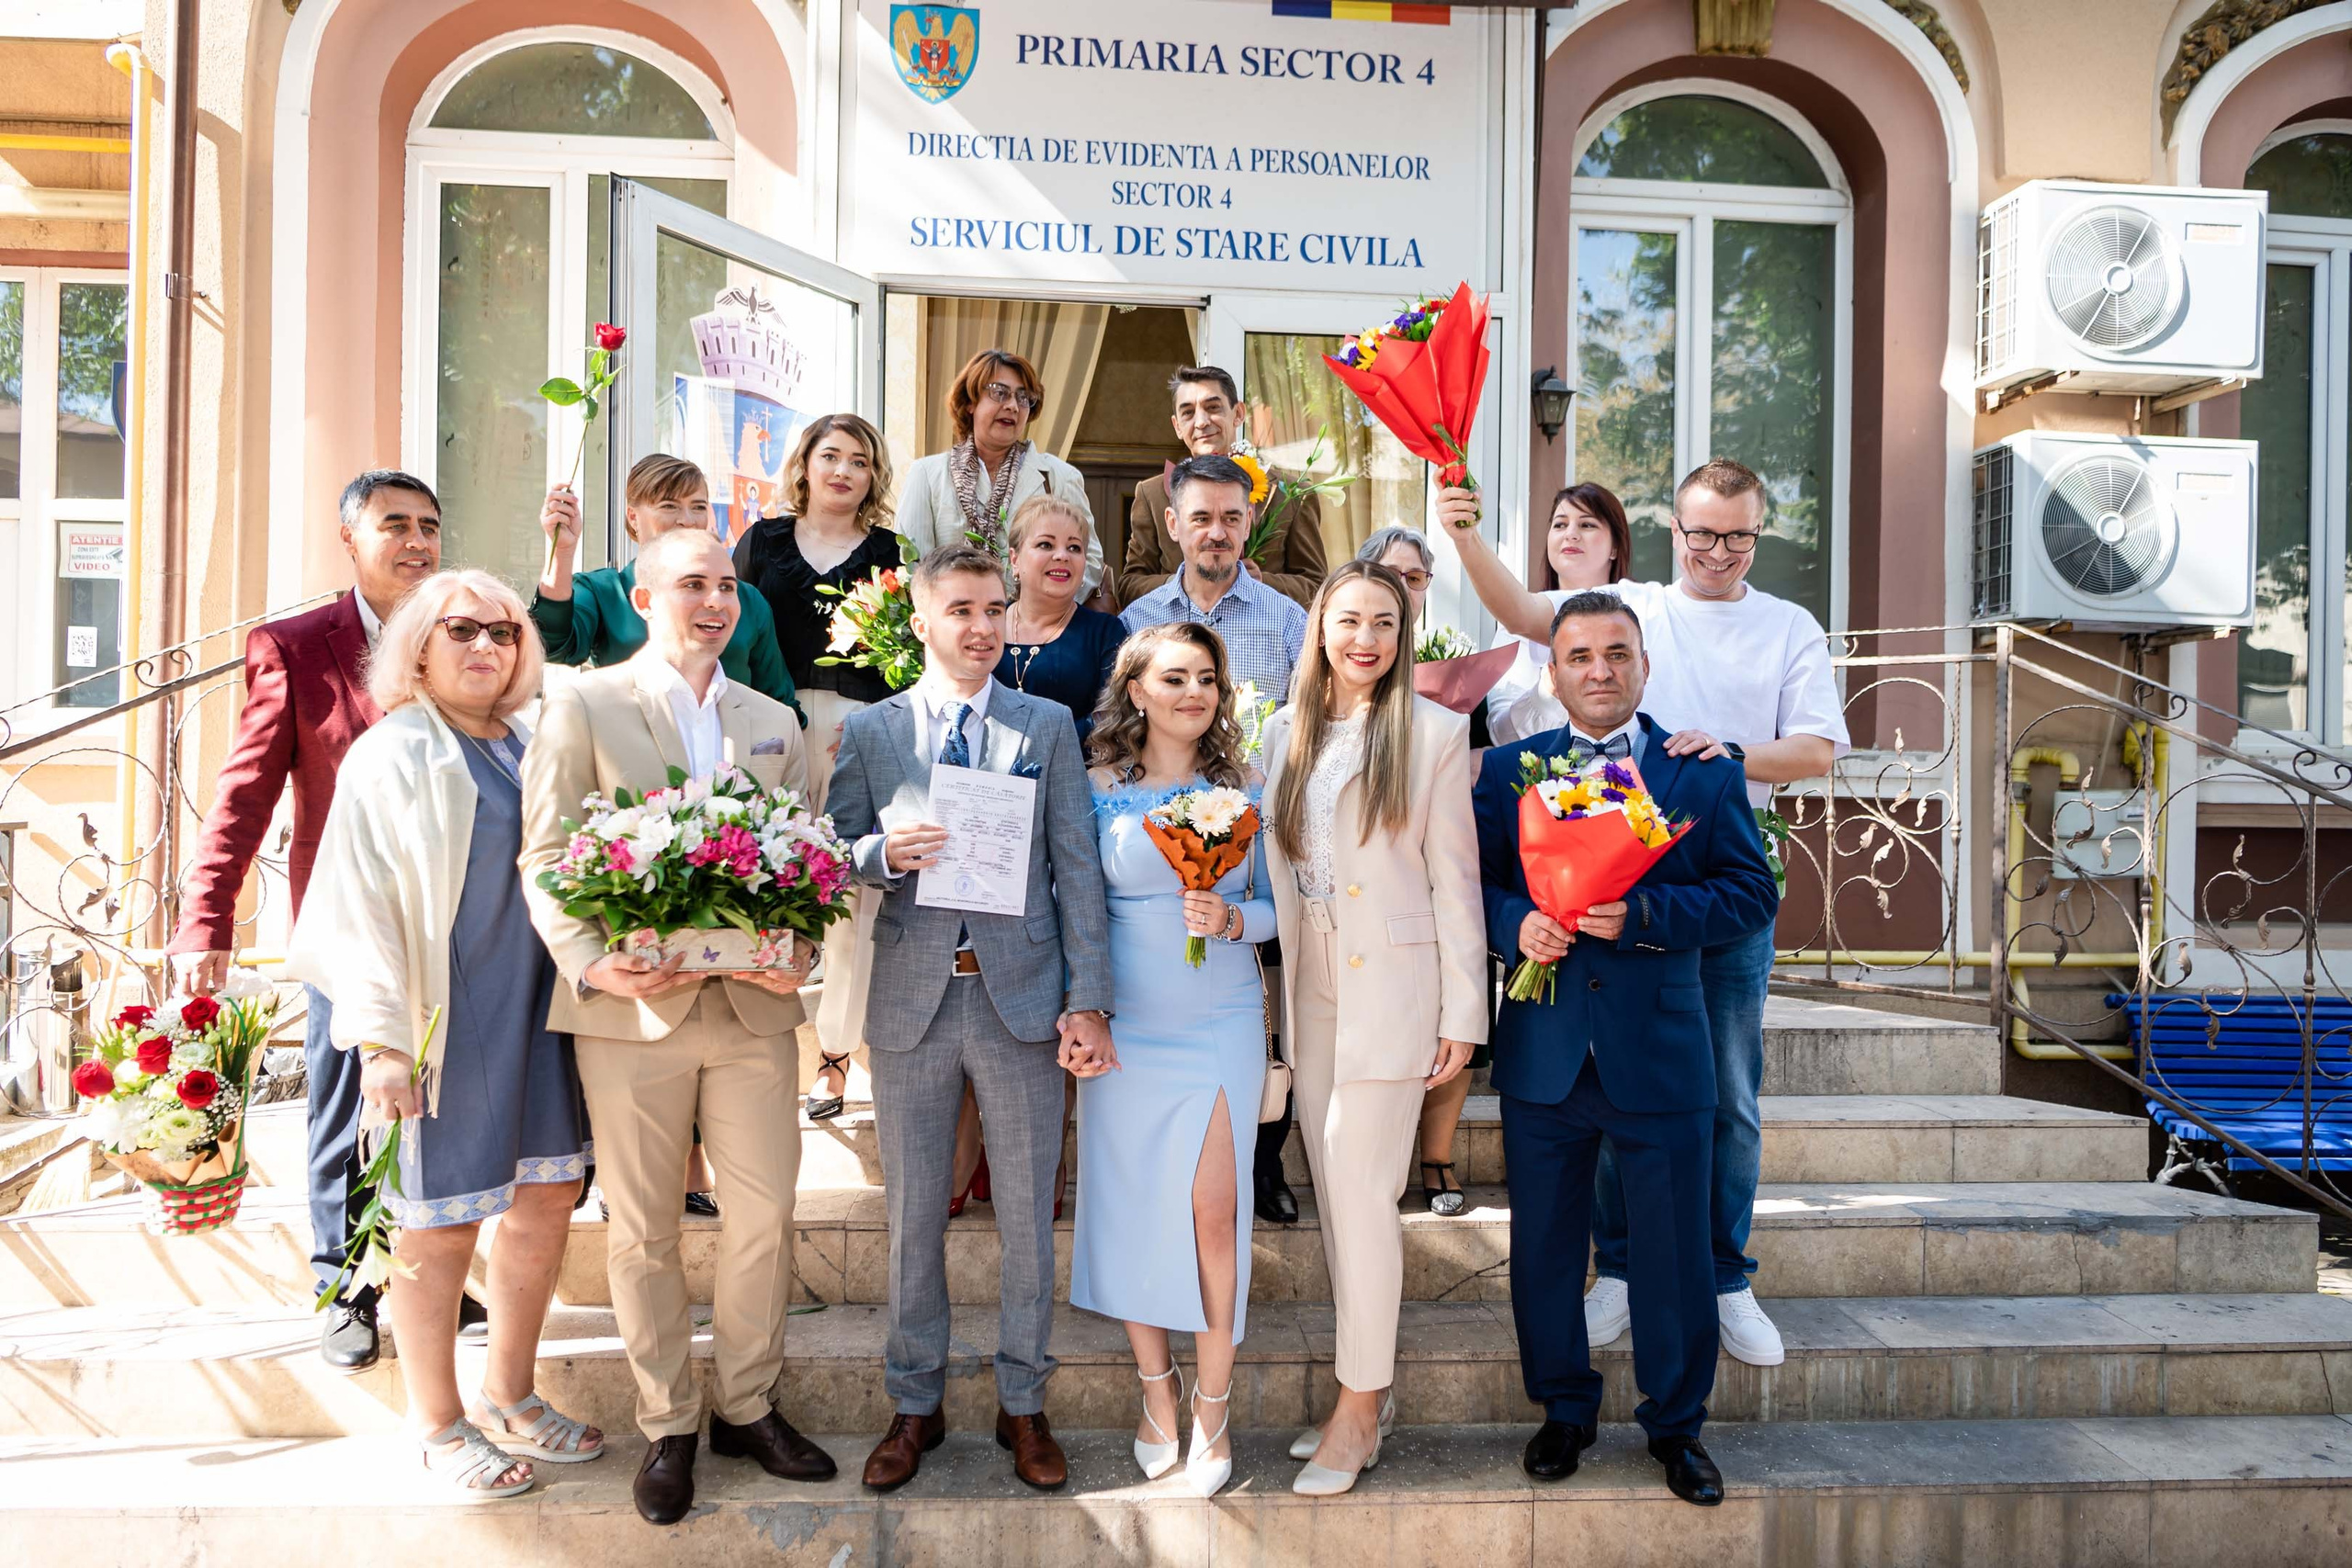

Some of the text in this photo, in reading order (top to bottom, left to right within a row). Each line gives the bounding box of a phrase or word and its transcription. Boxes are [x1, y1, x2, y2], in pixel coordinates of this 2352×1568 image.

[1015, 33, 1436, 86] PRIMARIA SECTOR 4
[907, 131, 1430, 181] DIRECTIA DE EVIDENTA A PERSOANELOR
[1112, 181, 1233, 210] SECTOR 4
[910, 217, 1426, 269] SERVICIUL DE STARE CIVILA
[72, 536, 119, 545] ATENTIE
[74, 562, 110, 570] VIDEO
